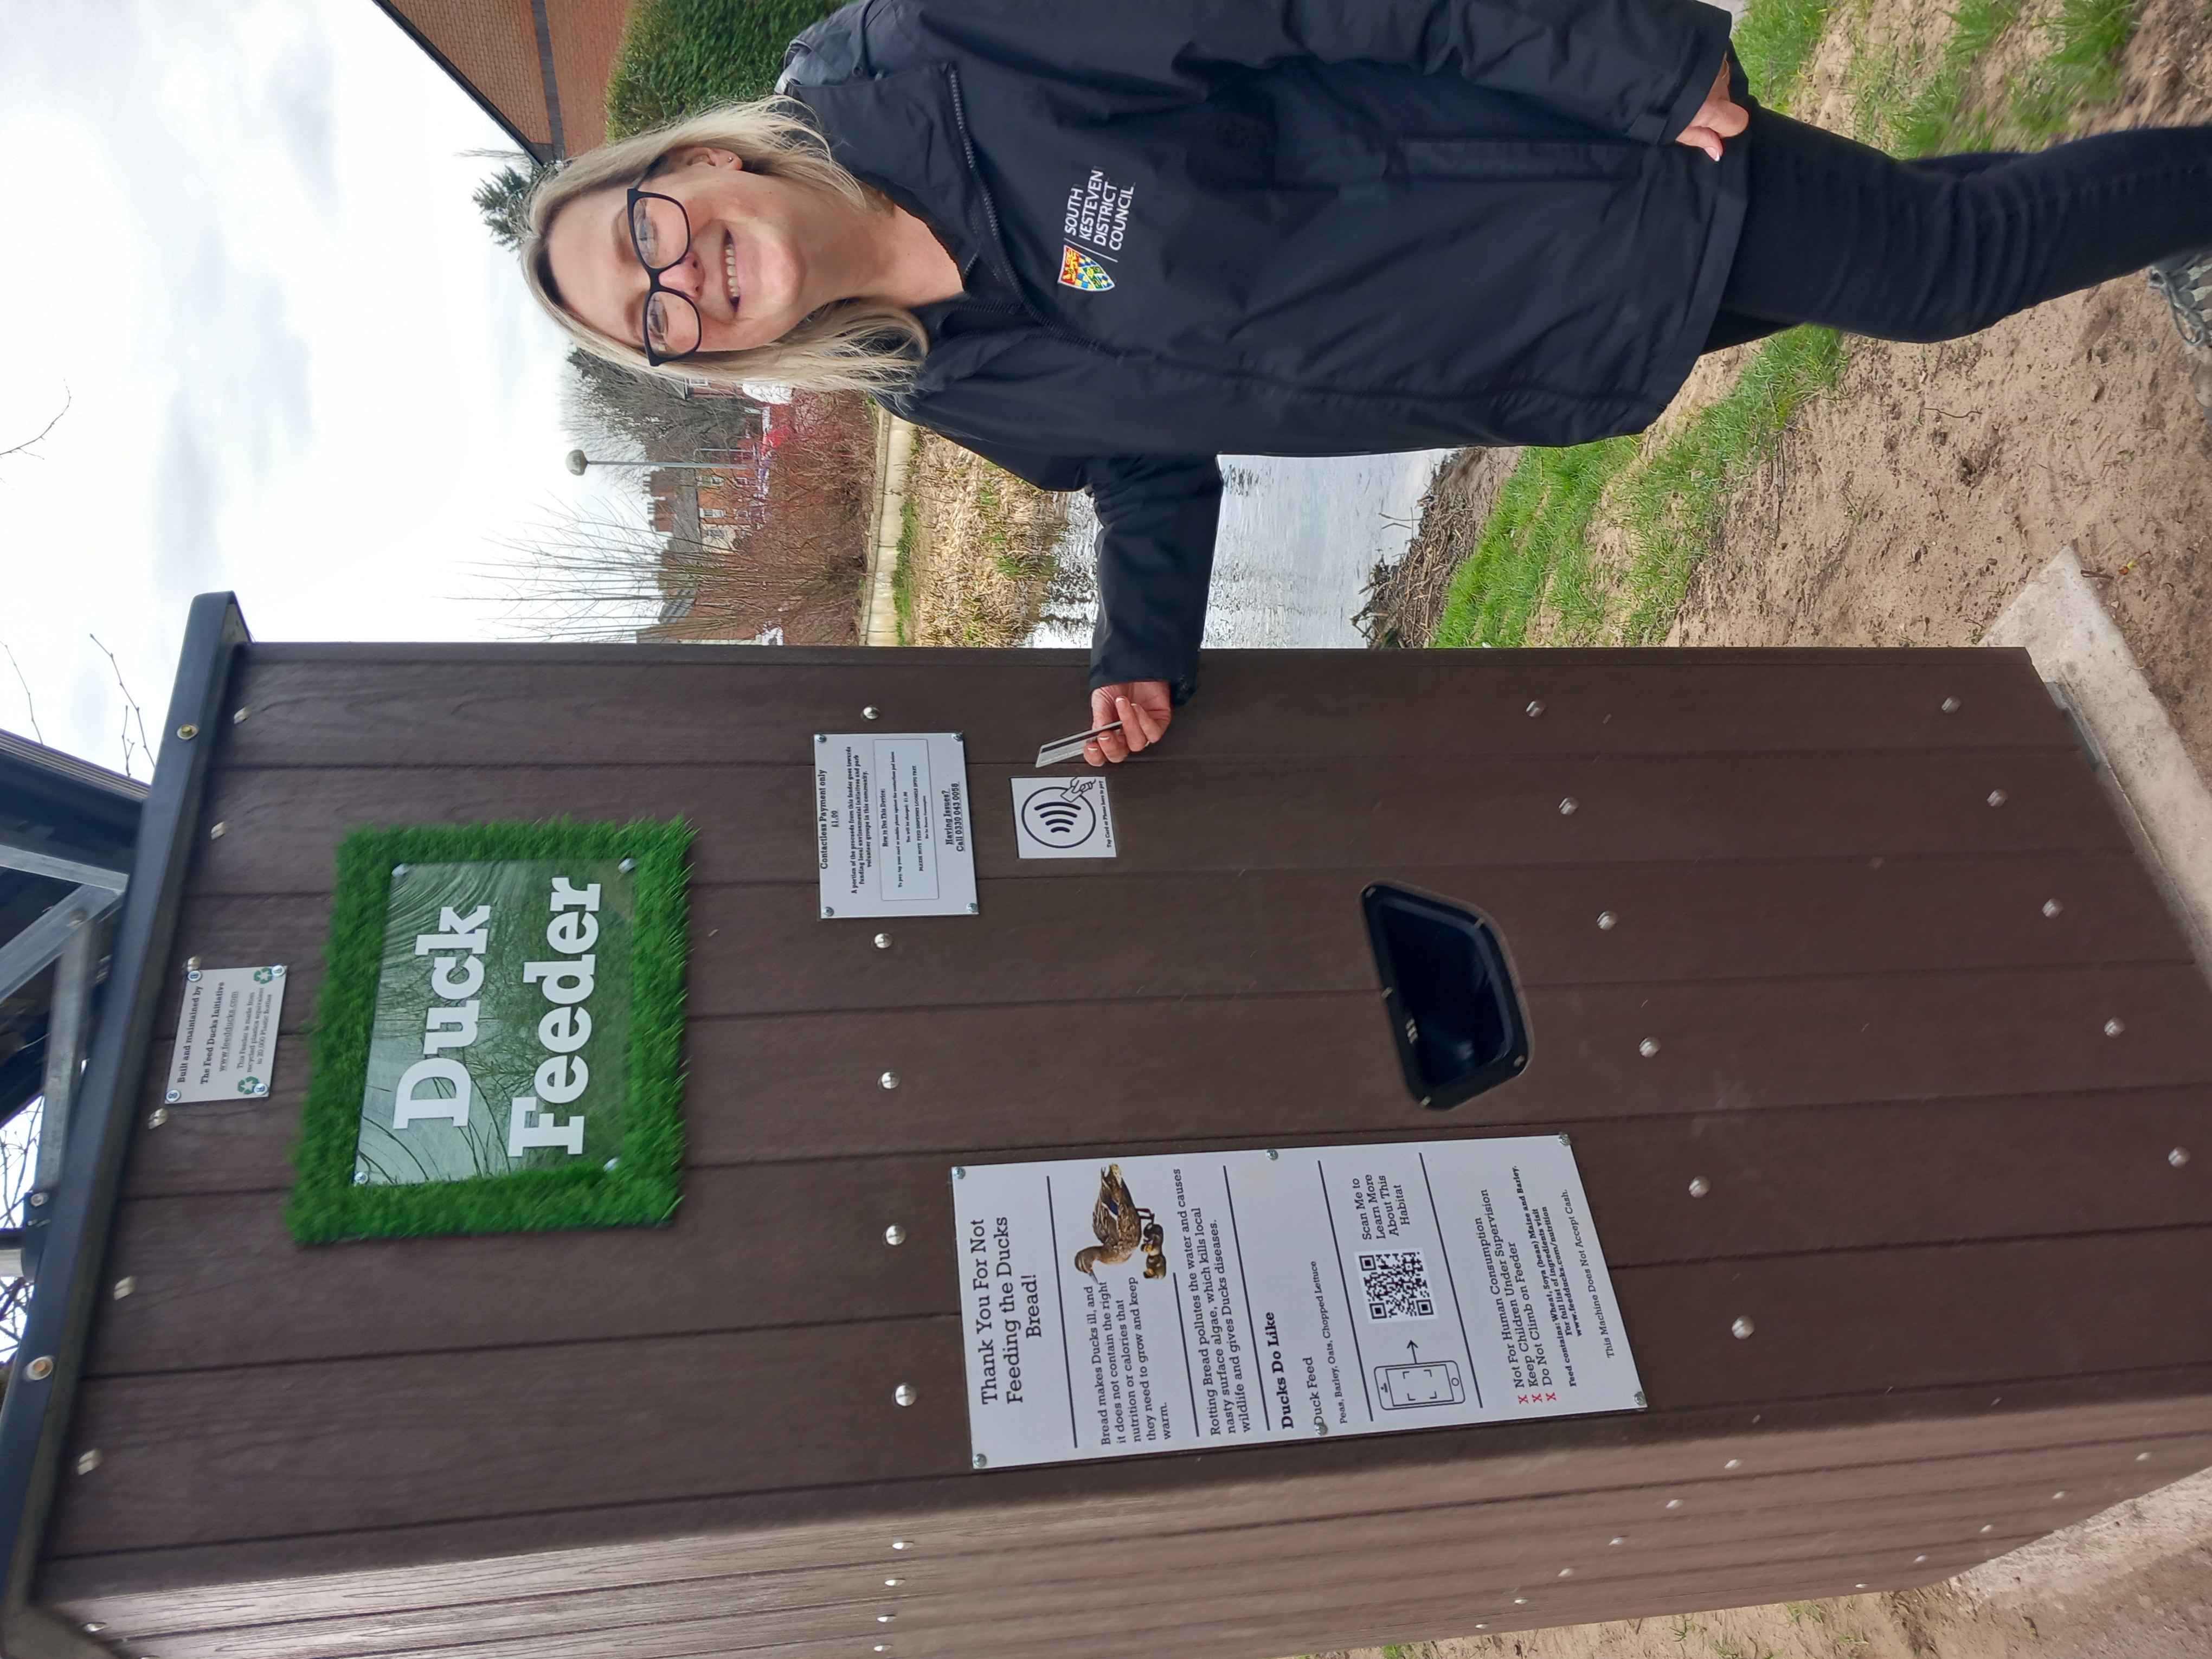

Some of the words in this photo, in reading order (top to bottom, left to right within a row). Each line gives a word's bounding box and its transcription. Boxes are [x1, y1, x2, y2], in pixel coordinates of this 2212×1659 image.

[1064, 188, 1084, 236] SOUTH
[1078, 169, 1103, 241] KESTEVEN
[1093, 181, 1117, 246] DISTRICT
[1109, 186, 1134, 250] COUNCIL
[818, 770, 827, 786] only
[819, 788, 828, 821] Payment
[941, 790, 950, 816] Issues?
[953, 802, 961, 815] 043
[954, 817, 962, 834] 0330
[820, 824, 828, 869] Contactless
[955, 837, 964, 852] Call
[192, 986, 203, 995] by
[211, 982, 224, 1018] Initiative
[186, 998, 200, 1043] maintained
[207, 1020, 218, 1045] Ducks
[219, 992, 237, 1071] www.feedducks.com
[393, 905, 491, 1129] Duck
[507, 877, 601, 1157] Feeder
[203, 1047, 214, 1066] Feed
[177, 1063, 188, 1083] Built
[200, 1069, 210, 1084] The
[1173, 1169, 1185, 1207] causes
[1353, 1179, 1360, 1188] to
[1365, 1174, 1378, 1203] More
[1378, 1175, 1390, 1199] This
[1512, 1166, 1523, 1194] Barley.
[1354, 1192, 1365, 1210] Me
[1393, 1185, 1410, 1225] Habitat
[1519, 1196, 1528, 1211] and
[1562, 1189, 1573, 1214] Cash.
[1178, 1210, 1189, 1232] and
[1192, 1207, 1204, 1236] local
[1360, 1212, 1372, 1240] Scan
[1373, 1206, 1386, 1239] Learn
[1384, 1201, 1399, 1236] About
[1481, 1189, 1504, 1257] Supervision
[1526, 1213, 1536, 1239] Maize
[1532, 1209, 1542, 1226] visit
[1568, 1217, 1584, 1248] Accept
[970, 1219, 986, 1253] Not
[994, 1217, 1012, 1277] Ducks
[1197, 1239, 1209, 1263] kills
[1210, 1220, 1225, 1274] diseases.
[1184, 1236, 1195, 1269] water
[1475, 1218, 1500, 1295] Consumption
[1508, 1242, 1525, 1283] Feeder
[1532, 1241, 1546, 1268] (bean)
[1539, 1229, 1556, 1276] ingredients
[1578, 1250, 1589, 1266] Not
[973, 1258, 989, 1290] For
[1188, 1273, 1198, 1291] the
[1201, 1266, 1214, 1303] which
[1311, 1261, 1322, 1294] Lettuce
[1500, 1259, 1514, 1297] Under
[1539, 1270, 1550, 1289] Soya
[1542, 1207, 1582, 1336] www.feedducks.com/nutrition
[1551, 1278, 1559, 1287] of
[1585, 1269, 1596, 1293] Does
[999, 1283, 1015, 1313] the
[1020, 1275, 1041, 1338] Bread!
[1083, 1286, 1095, 1308] and
[1097, 1281, 1111, 1310] right
[1129, 1277, 1139, 1306] keep
[1219, 1277, 1232, 1315] Ducks
[1520, 1285, 1529, 1300] on
[1546, 1291, 1559, 1322] Wheat,
[1554, 1289, 1564, 1302] list
[976, 1295, 992, 1334] You
[1086, 1310, 1097, 1324] ill,
[1103, 1313, 1112, 1330] the
[1116, 1300, 1126, 1321] that
[1130, 1308, 1141, 1330] and
[1193, 1295, 1210, 1345] pollutes
[1210, 1307, 1223, 1345] algae,
[1316, 1296, 1330, 1339] Chopped
[1496, 1298, 1513, 1340] Human
[1510, 1299, 1529, 1352] Children
[1523, 1304, 1540, 1340] Climb
[1558, 1304, 1568, 1319] full
[1592, 1295, 1608, 1335] Machine
[1226, 1319, 1240, 1352] gives
[1265, 1312, 1279, 1347] Like
[1555, 1323, 1570, 1363] contains:
[1559, 1321, 1572, 1337] For
[1089, 1327, 1101, 1364] Ducks
[1105, 1334, 1118, 1377] contain
[1119, 1324, 1132, 1371] calories
[1136, 1334, 1148, 1363] grow
[1327, 1340, 1335, 1364] Oats,
[1507, 1343, 1518, 1364] For
[1534, 1343, 1547, 1365] Not
[1604, 1338, 1615, 1358] This
[978, 1339, 998, 1405] Thank
[1002, 1319, 1023, 1404] Feeding
[1140, 1366, 1148, 1378] to
[1198, 1348, 1213, 1386] Bread
[1216, 1349, 1230, 1396] surface
[1229, 1356, 1242, 1380] and
[1272, 1351, 1284, 1373] Do
[1302, 1356, 1317, 1388] Feed
[1512, 1366, 1525, 1388] Not
[1525, 1355, 1539, 1387] Keep
[1542, 1368, 1552, 1386] Do
[1565, 1365, 1577, 1387] Feed
[1095, 1367, 1106, 1406] makes
[1110, 1380, 1120, 1399] not
[1126, 1375, 1134, 1387] or
[1140, 1380, 1152, 1411] need
[1332, 1366, 1342, 1398] Barley,
[1115, 1403, 1124, 1432] does
[1128, 1390, 1141, 1442] nutrition
[1207, 1389, 1221, 1436] Rotting
[1223, 1399, 1236, 1433] nasty
[1234, 1384, 1251, 1432] wildlife
[1276, 1377, 1294, 1429] Ducks
[1310, 1391, 1326, 1425] Duck
[1338, 1399, 1347, 1424] Peas,
[1097, 1409, 1111, 1445] Bread
[1146, 1415, 1156, 1441] they
[1160, 1403, 1171, 1440] warm.
